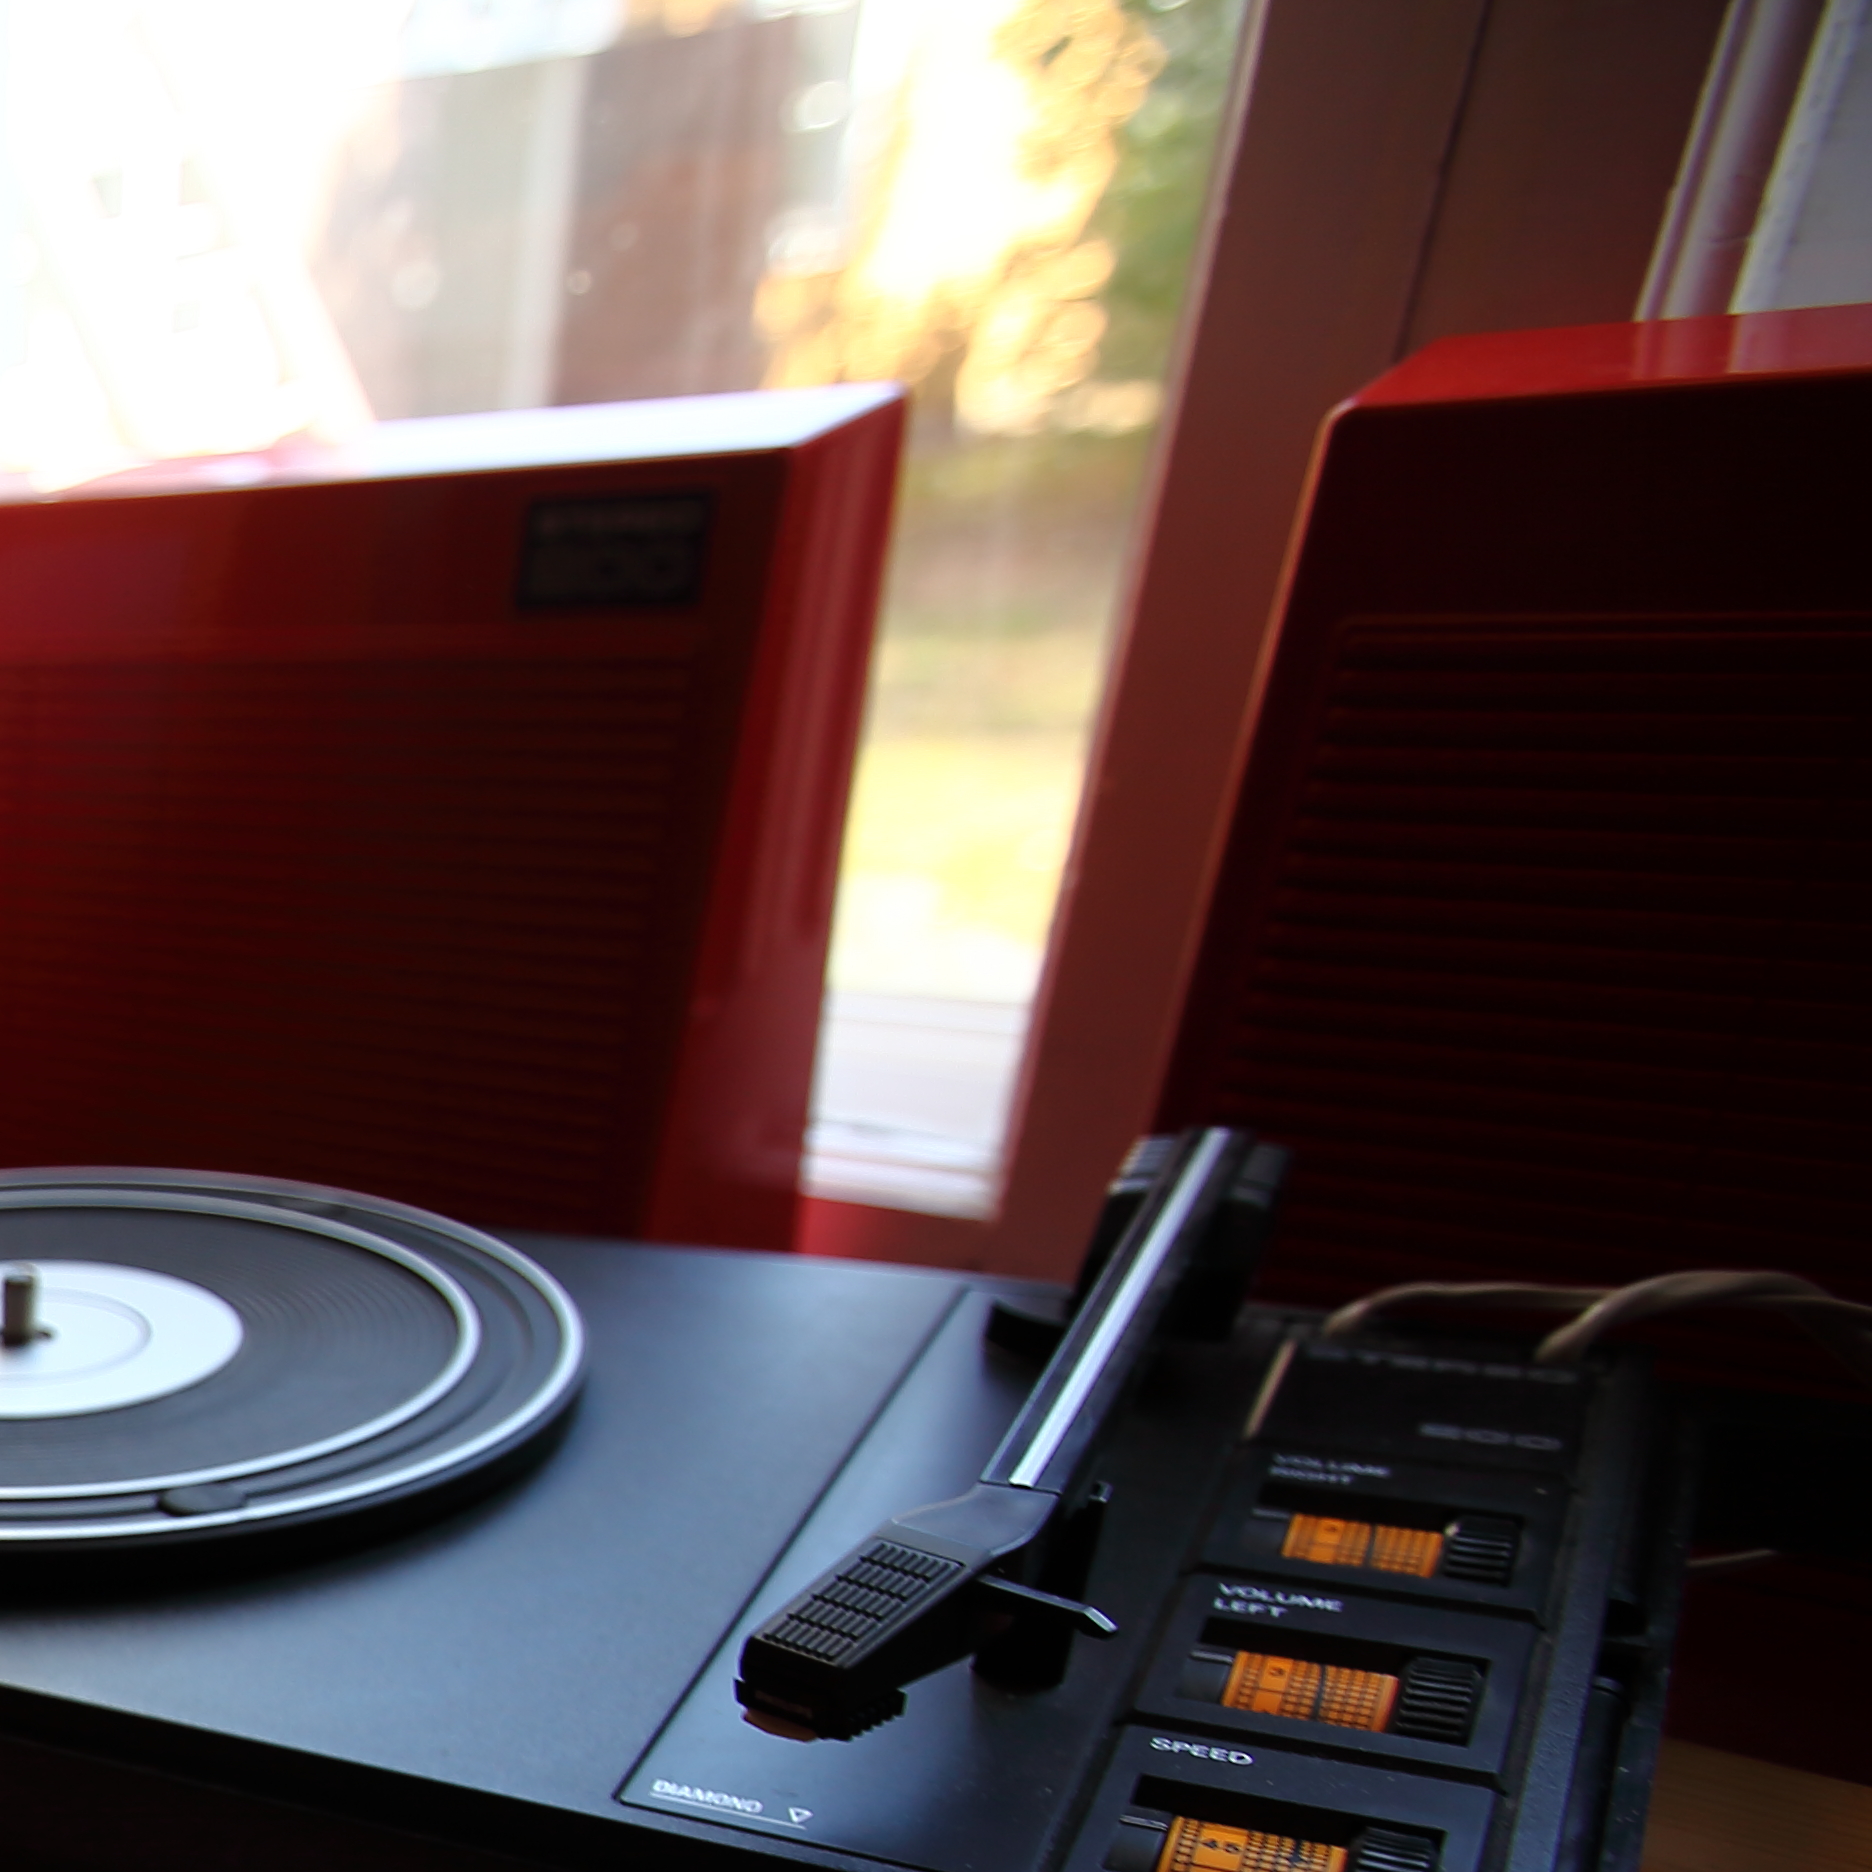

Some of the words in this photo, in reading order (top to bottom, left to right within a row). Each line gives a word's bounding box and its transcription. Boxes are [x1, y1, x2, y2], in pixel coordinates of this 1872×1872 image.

[1213, 1597, 1288, 1618] LEFT
[1218, 1582, 1344, 1612] VOLUME
[1150, 1736, 1254, 1766] SPEED
[652, 1778, 764, 1814] DIAMOND
